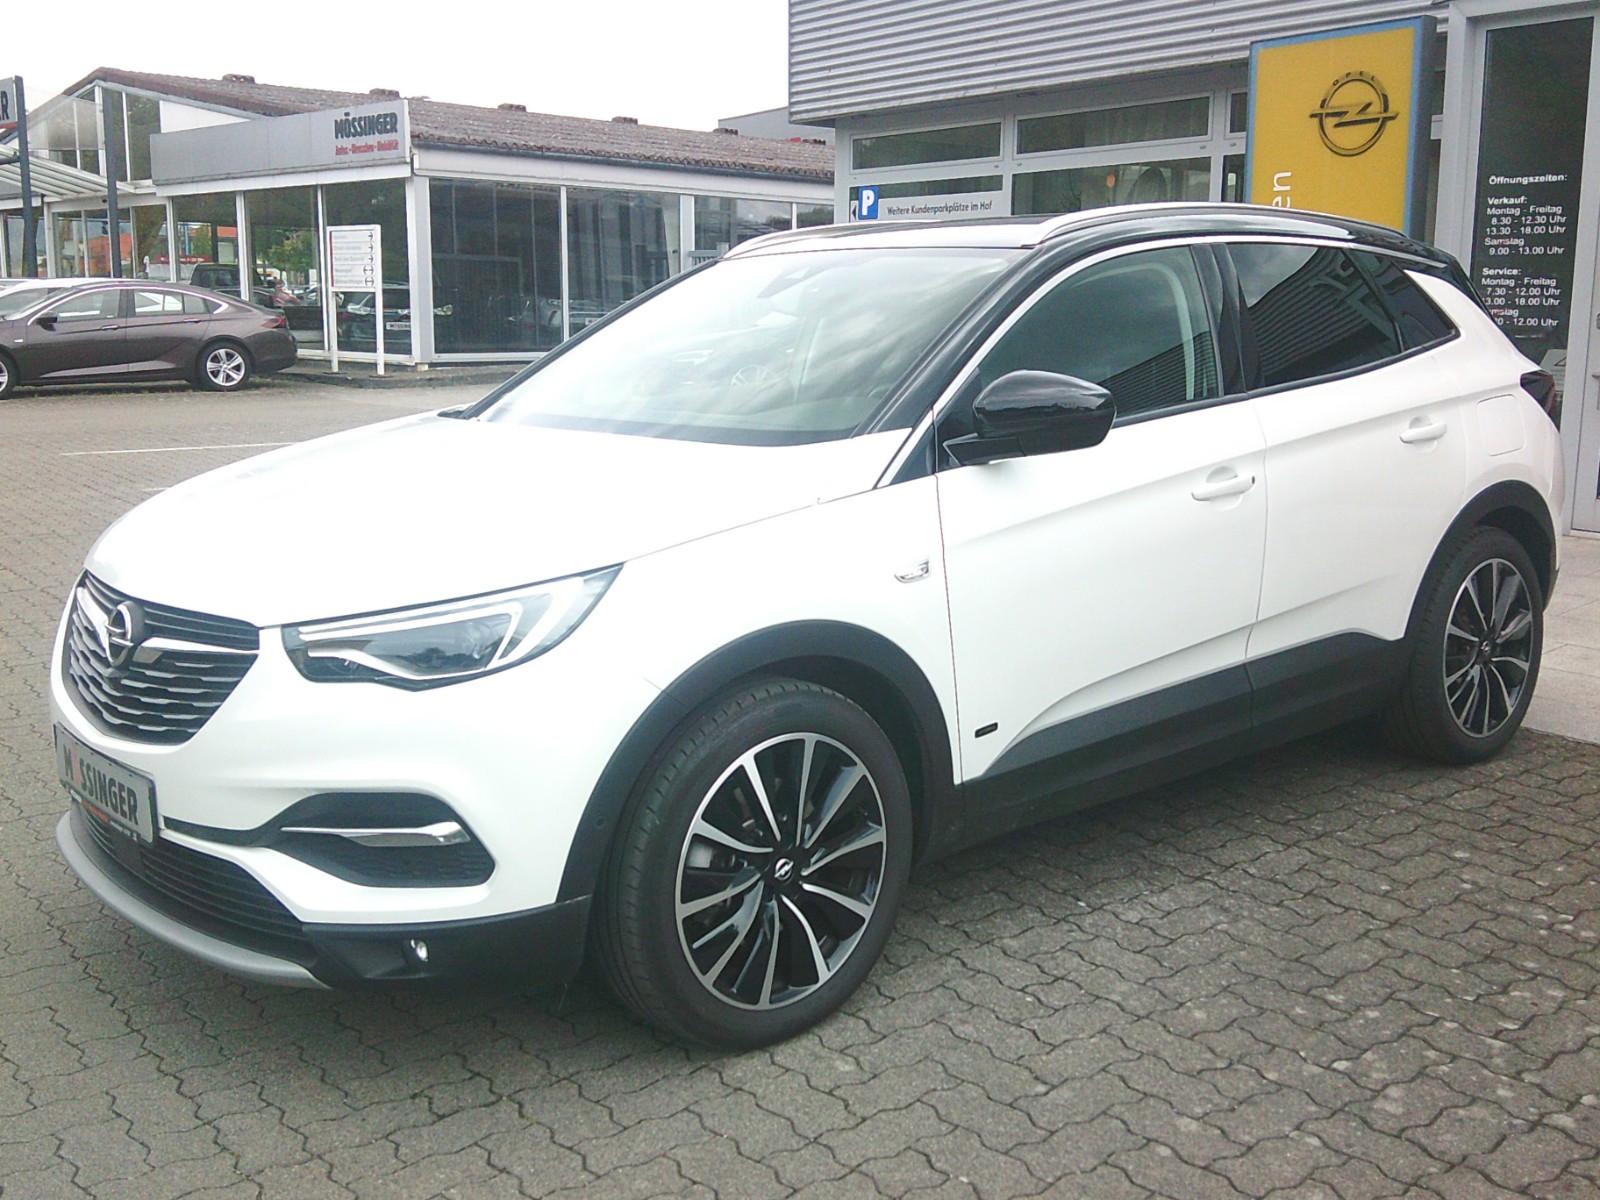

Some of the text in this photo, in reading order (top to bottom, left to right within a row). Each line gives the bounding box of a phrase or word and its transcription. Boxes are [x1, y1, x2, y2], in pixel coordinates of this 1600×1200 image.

[334, 111, 398, 139] MÖSSINGER
[1489, 174, 1568, 184] Öffnungszeiten:
[862, 189, 875, 215] P
[1487, 195, 1528, 205] Verkauf:
[887, 200, 993, 216] Weitere Kundenparkplätze im Hof
[1486, 207, 1521, 216] Montag
[1529, 205, 1563, 214] Freitag
[1491, 216, 1511, 225] 8.30
[1521, 215, 1547, 224] 12.30
[1549, 215, 1567, 223] Uhr
[1486, 227, 1511, 235] 13.30
[1520, 225, 1546, 234] 18.00
[1548, 225, 1566, 233] Uhr
[1484, 237, 1525, 247] Samstag
[1489, 247, 1509, 255] 9.00
[1518, 246, 1544, 255] 13.00
[1546, 246, 1565, 254] Uhr
[1482, 267, 1522, 276] Service:
[1481, 277, 1515, 287] Montag
[1523, 277, 1557, 287] Freitag
[1486, 287, 1506, 296] 7.30
[1515, 287, 1541, 296] 12.00
[1543, 287, 1562, 296] Uhr
[1514, 297, 1540, 306] 18.00
[1542, 297, 1560, 306] Uhr
[1513, 318, 1538, 326] 12.00
[1540, 317, 1560, 327] Uhr
